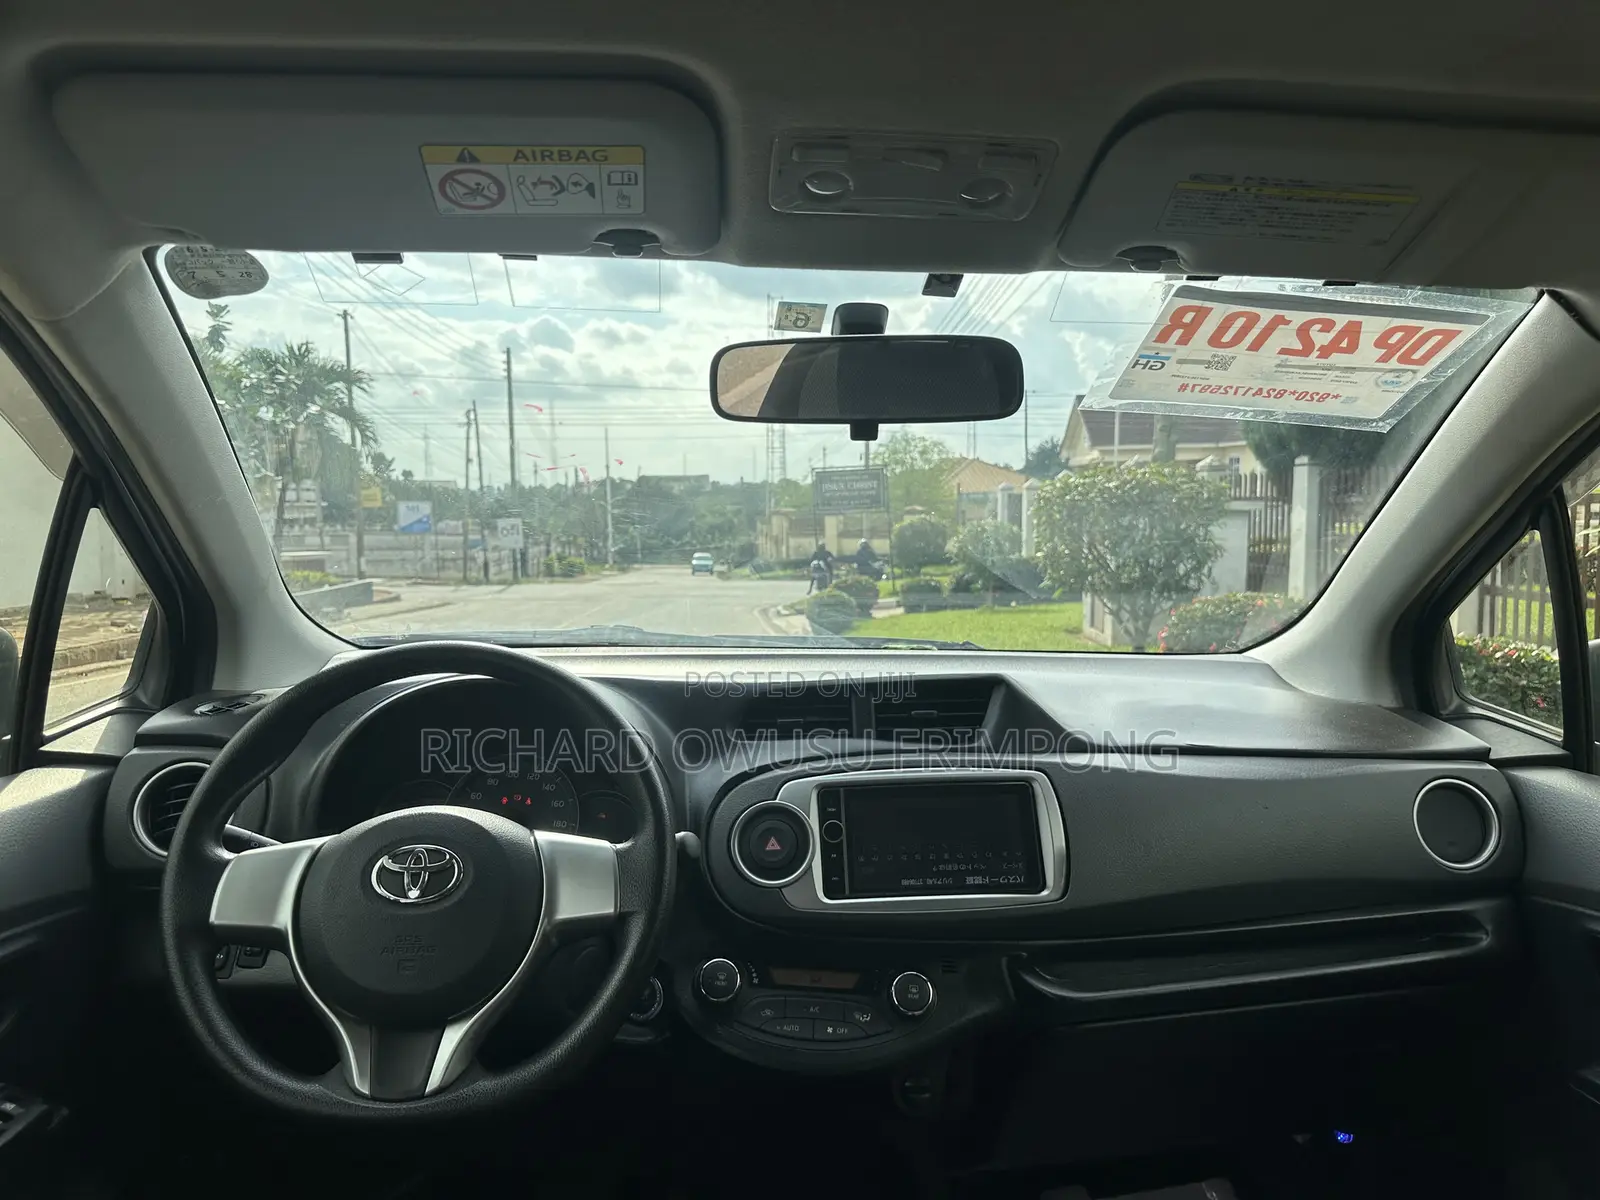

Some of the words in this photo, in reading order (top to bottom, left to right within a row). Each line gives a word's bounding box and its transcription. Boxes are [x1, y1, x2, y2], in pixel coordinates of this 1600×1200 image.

[513, 149, 609, 162] AIRBAG
[487, 778, 499, 786] 80
[542, 784, 556, 792] 140
[470, 792, 483, 800] 60
[551, 800, 565, 808] 160
[553, 820, 567, 828] 180
[809, 1005, 820, 1014] A/C
[782, 1024, 801, 1033] AUTO
